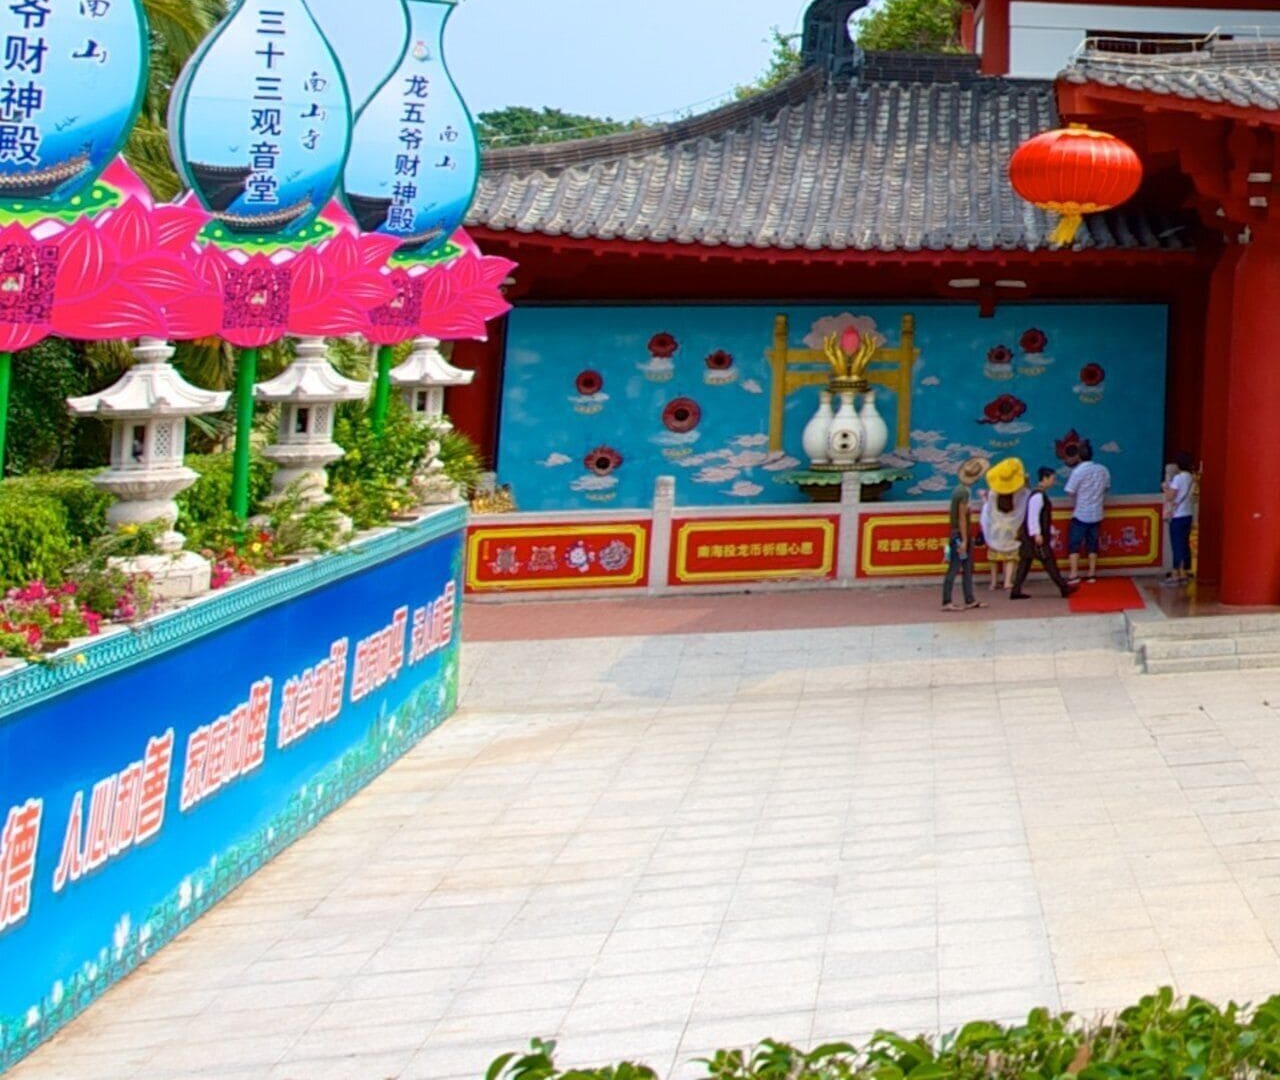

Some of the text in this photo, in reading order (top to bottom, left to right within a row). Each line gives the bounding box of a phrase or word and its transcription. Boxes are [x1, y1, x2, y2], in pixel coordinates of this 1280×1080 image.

[247, 10, 286, 203] 三十三观音堂
[386, 75, 430, 230] 龙五爷财神殿
[52, 726, 175, 893] 人心和善
